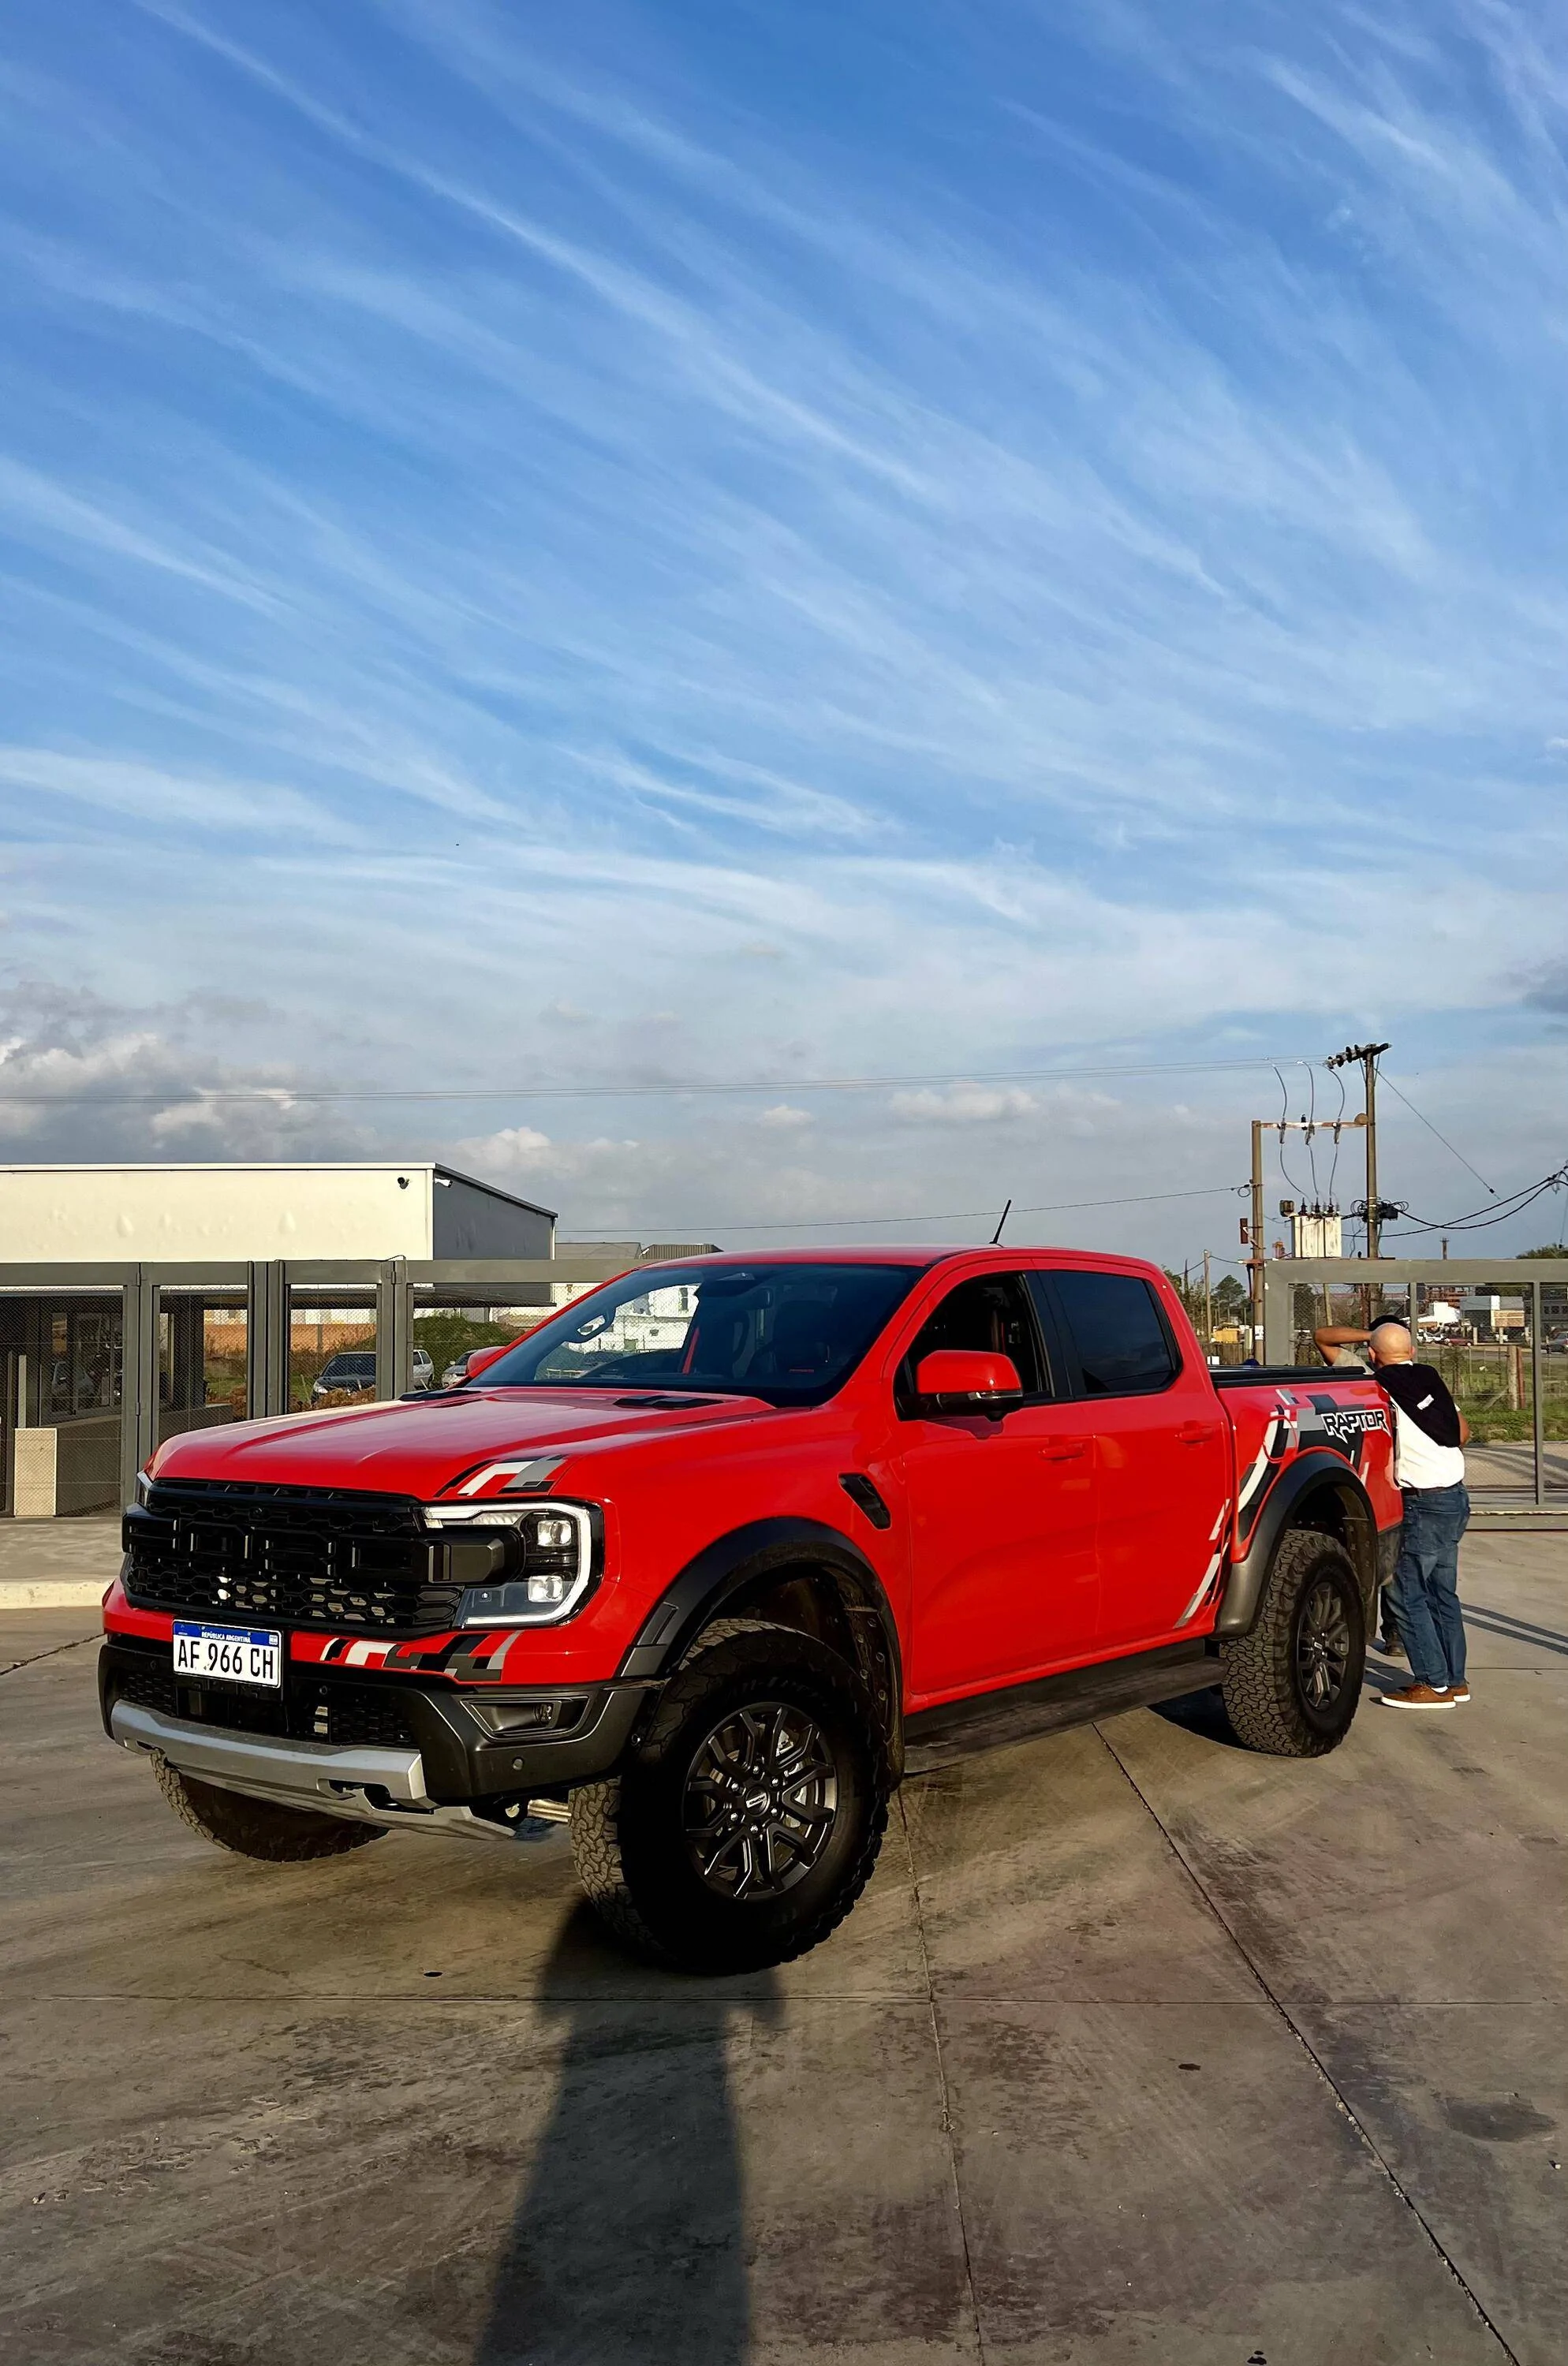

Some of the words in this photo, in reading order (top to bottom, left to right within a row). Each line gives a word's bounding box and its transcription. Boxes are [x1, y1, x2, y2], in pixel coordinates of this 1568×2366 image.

[1321, 1409, 1392, 1444] RAPTOR
[201, 1631, 226, 1640] REPÚBLICA
[226, 1634, 252, 1643] ARGENTINA
[178, 1639, 200, 1669] AF
[208, 1643, 242, 1674] 966
[250, 1648, 273, 1679] CH
